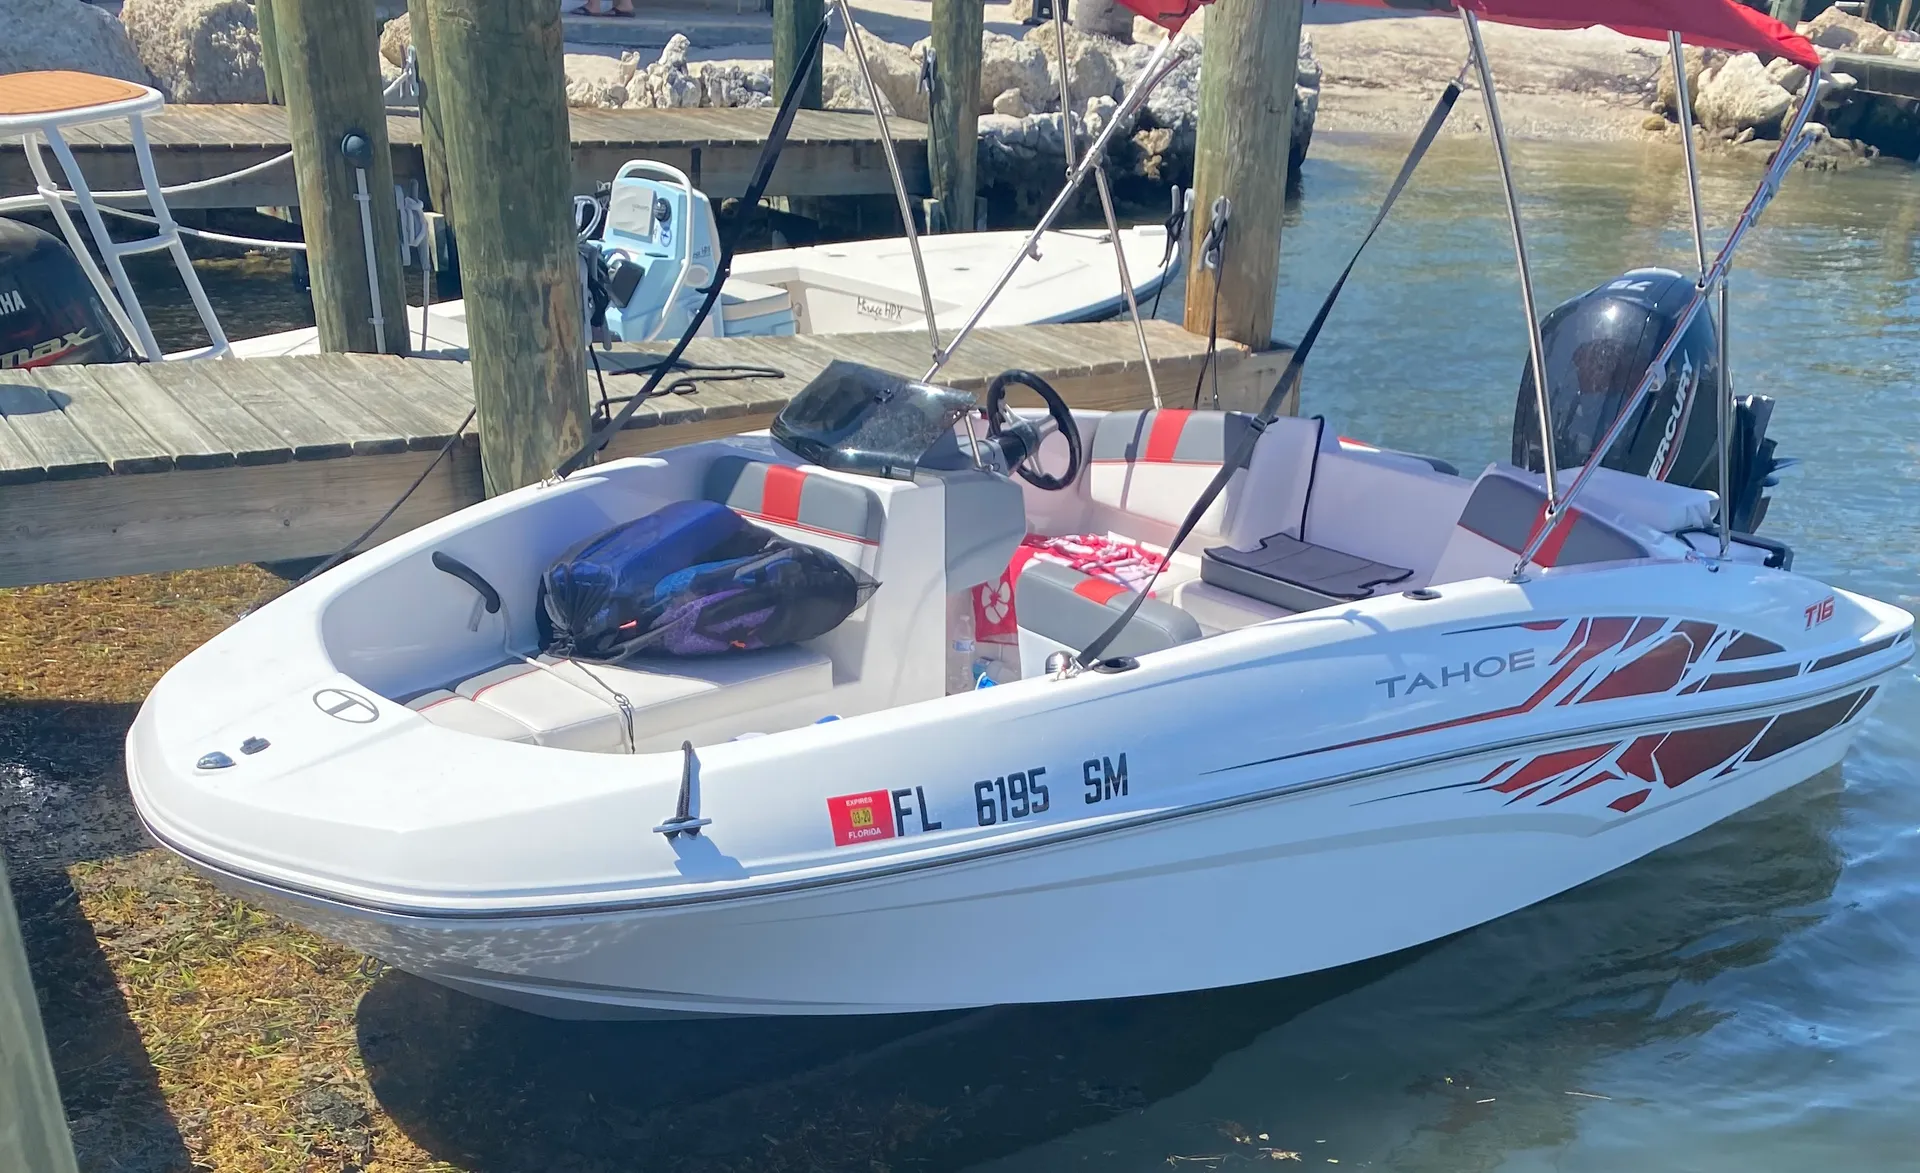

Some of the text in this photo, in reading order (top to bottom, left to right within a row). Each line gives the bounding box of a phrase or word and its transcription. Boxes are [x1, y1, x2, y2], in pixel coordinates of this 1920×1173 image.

[0, 289, 27, 316] HA
[1646, 348, 1693, 481] ERCURY
[1375, 647, 1535, 699] TAHOE
[845, 796, 873, 807] EXPIRES
[891, 752, 1128, 837] FL 6195 SM
[847, 827, 882, 840] FLORIDA
